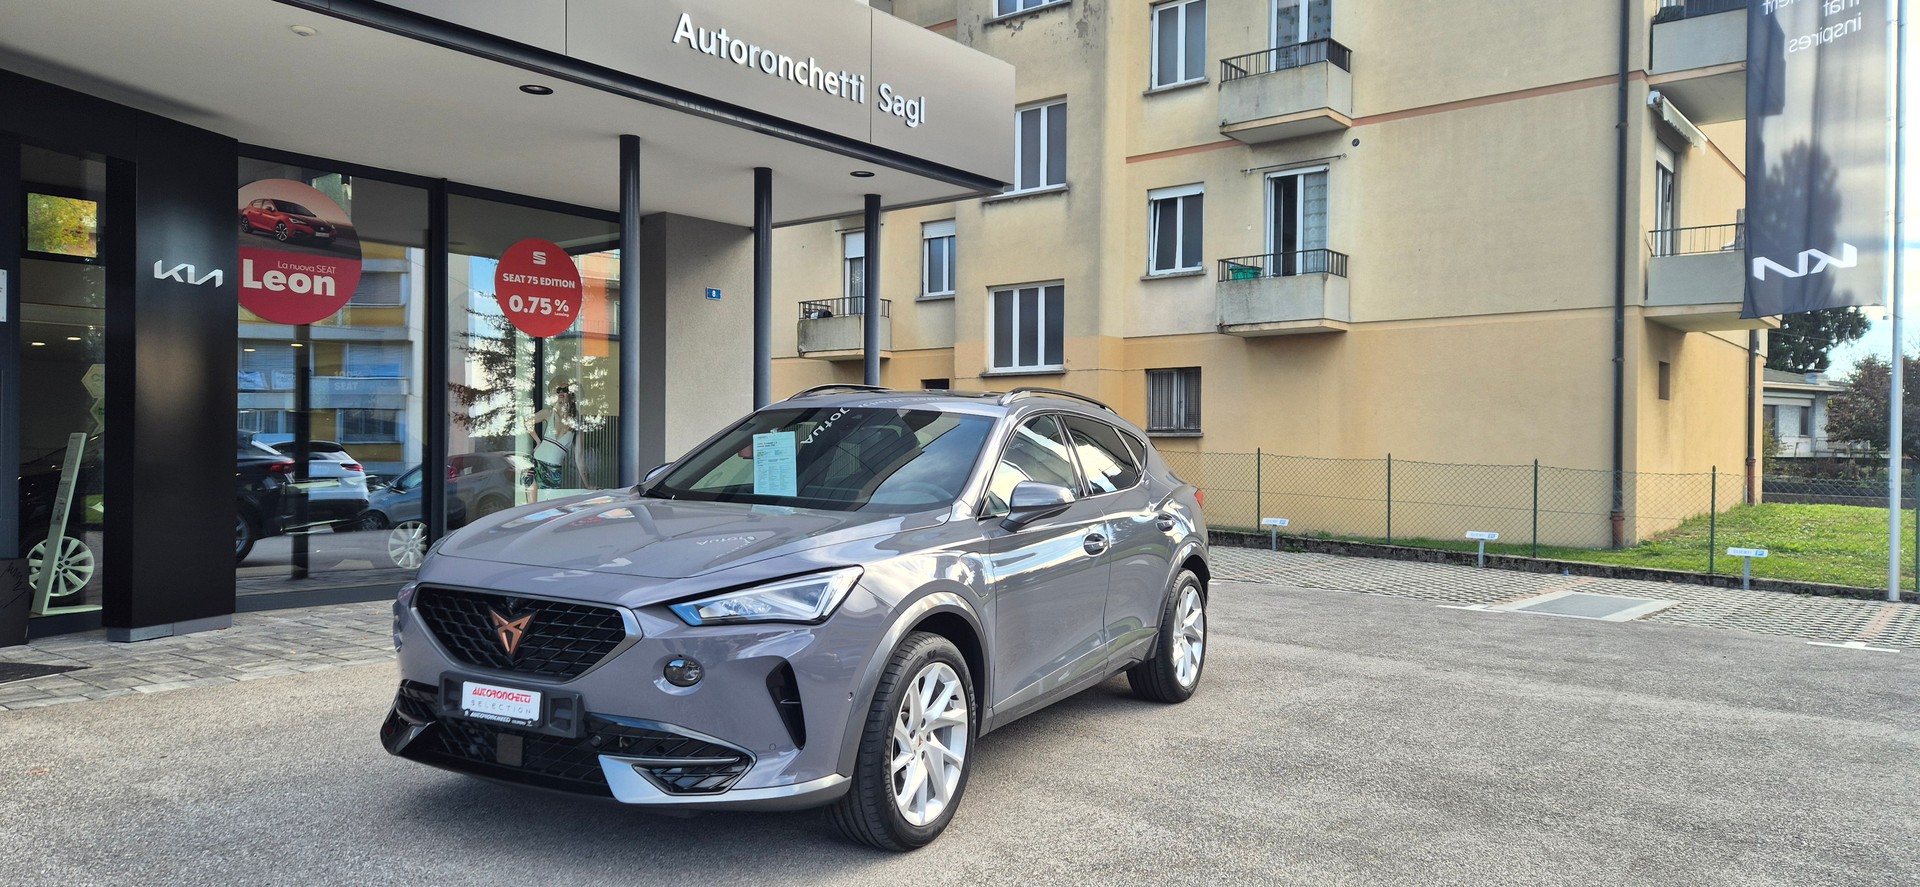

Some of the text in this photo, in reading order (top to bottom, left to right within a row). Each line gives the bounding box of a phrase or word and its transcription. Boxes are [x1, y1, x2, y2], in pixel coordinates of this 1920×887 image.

[672, 12, 926, 128] Autoronchetti Sagl
[278, 261, 336, 274] La nuova SEAT
[242, 258, 336, 296] Leon
[502, 273, 576, 289] SEAT 75 EDITION
[711, 289, 717, 298] 8
[334, 382, 358, 391] SEAT
[472, 687, 532, 704] AUTORONCHETTI
[471, 700, 531, 714] SELECTION
